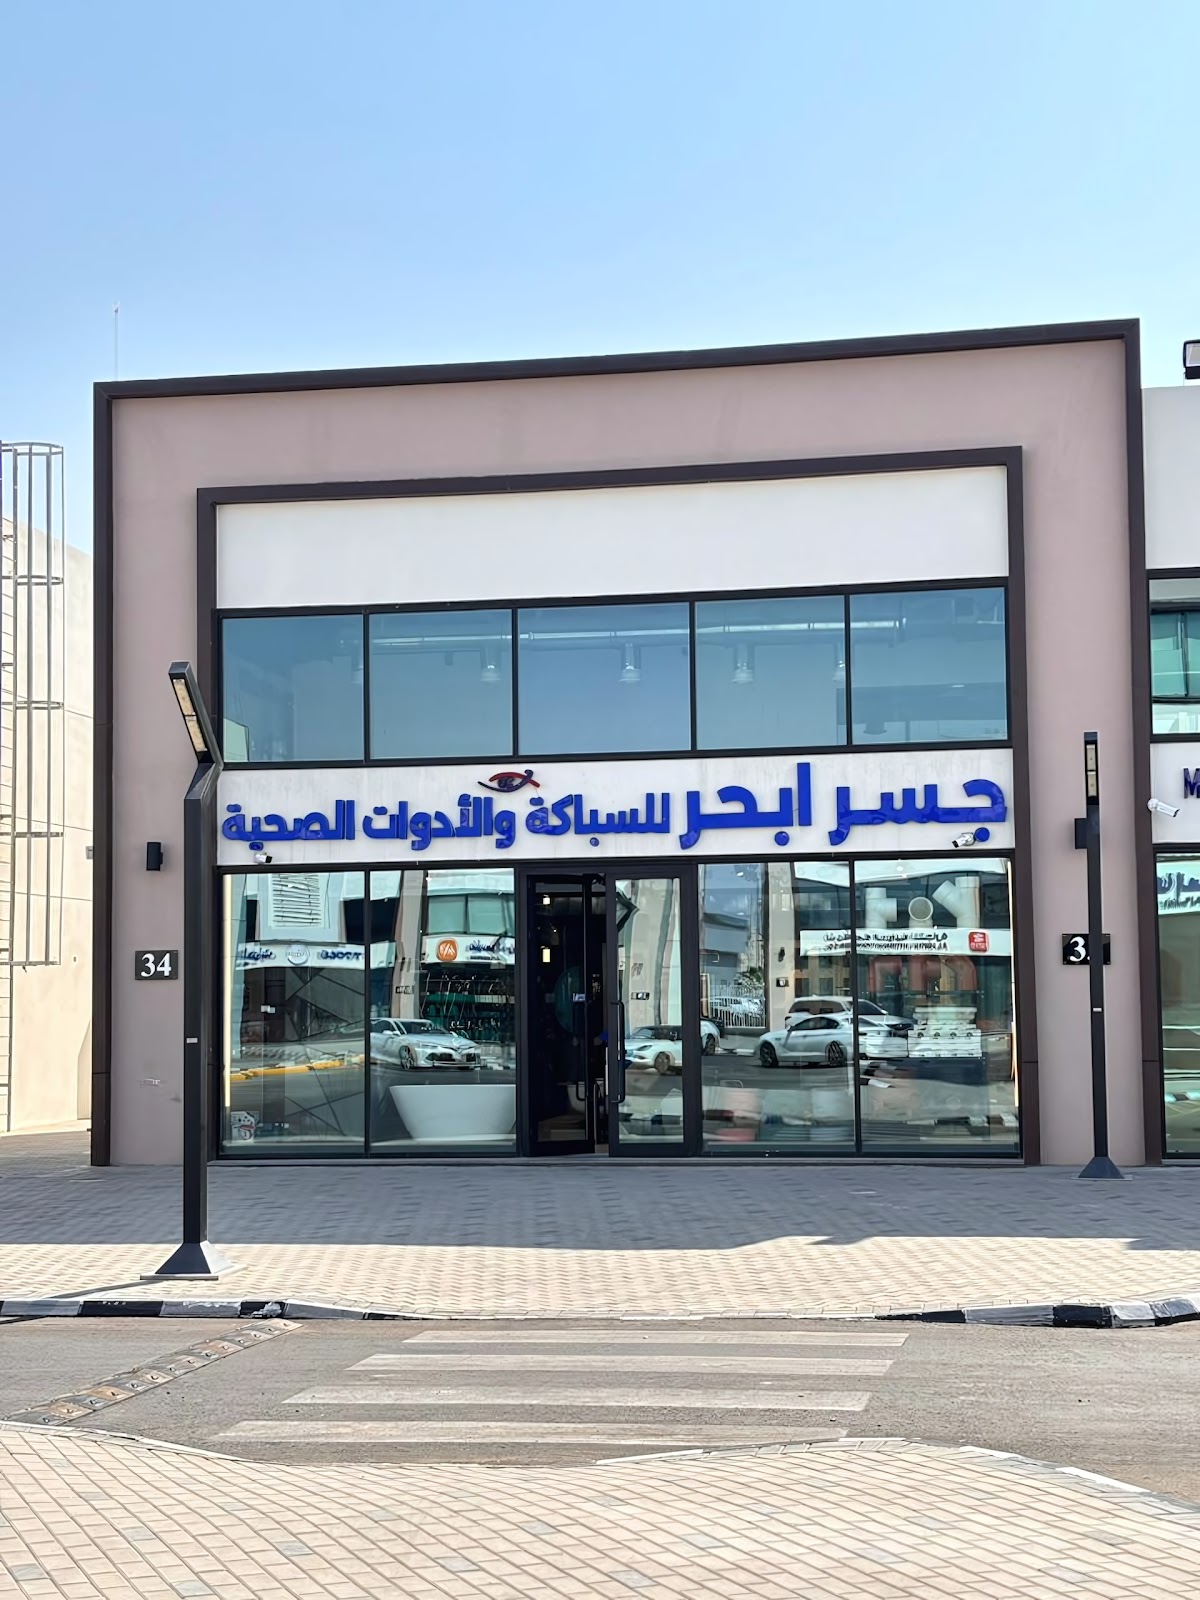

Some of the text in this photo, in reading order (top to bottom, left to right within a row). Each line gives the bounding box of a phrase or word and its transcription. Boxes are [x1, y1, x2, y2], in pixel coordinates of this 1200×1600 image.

[221, 762, 1008, 851] جسر ابحر للسباكة والأدوات الصحية
[1069, 936, 1091, 962] 3
[140, 952, 172, 978] 34
